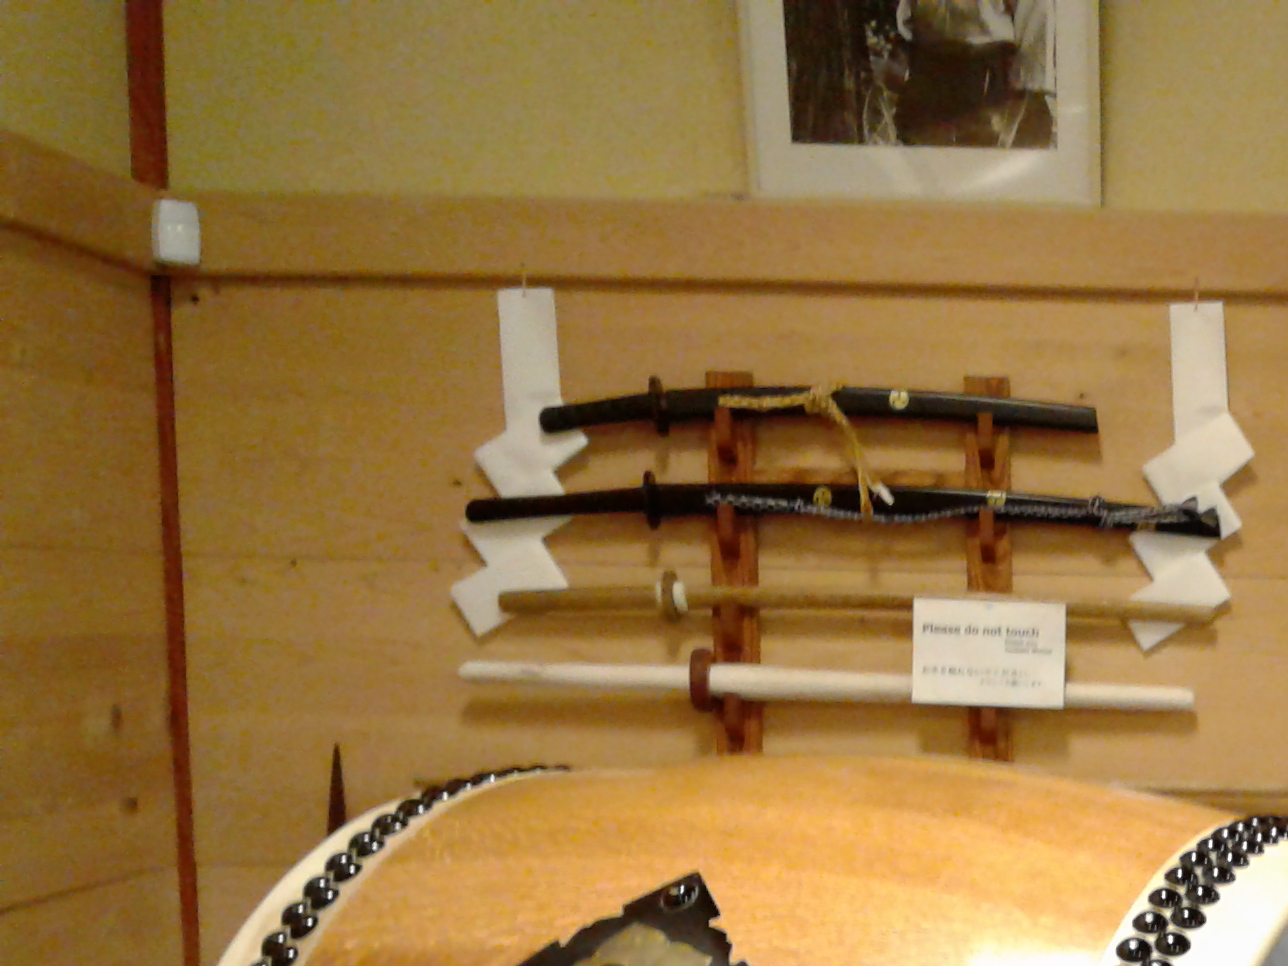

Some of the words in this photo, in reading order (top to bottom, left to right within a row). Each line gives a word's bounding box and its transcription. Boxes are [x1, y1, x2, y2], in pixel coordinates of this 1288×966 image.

[922, 623, 961, 635] Please
[964, 625, 979, 635] do
[982, 626, 1002, 636] not
[1005, 627, 1039, 637] touch
